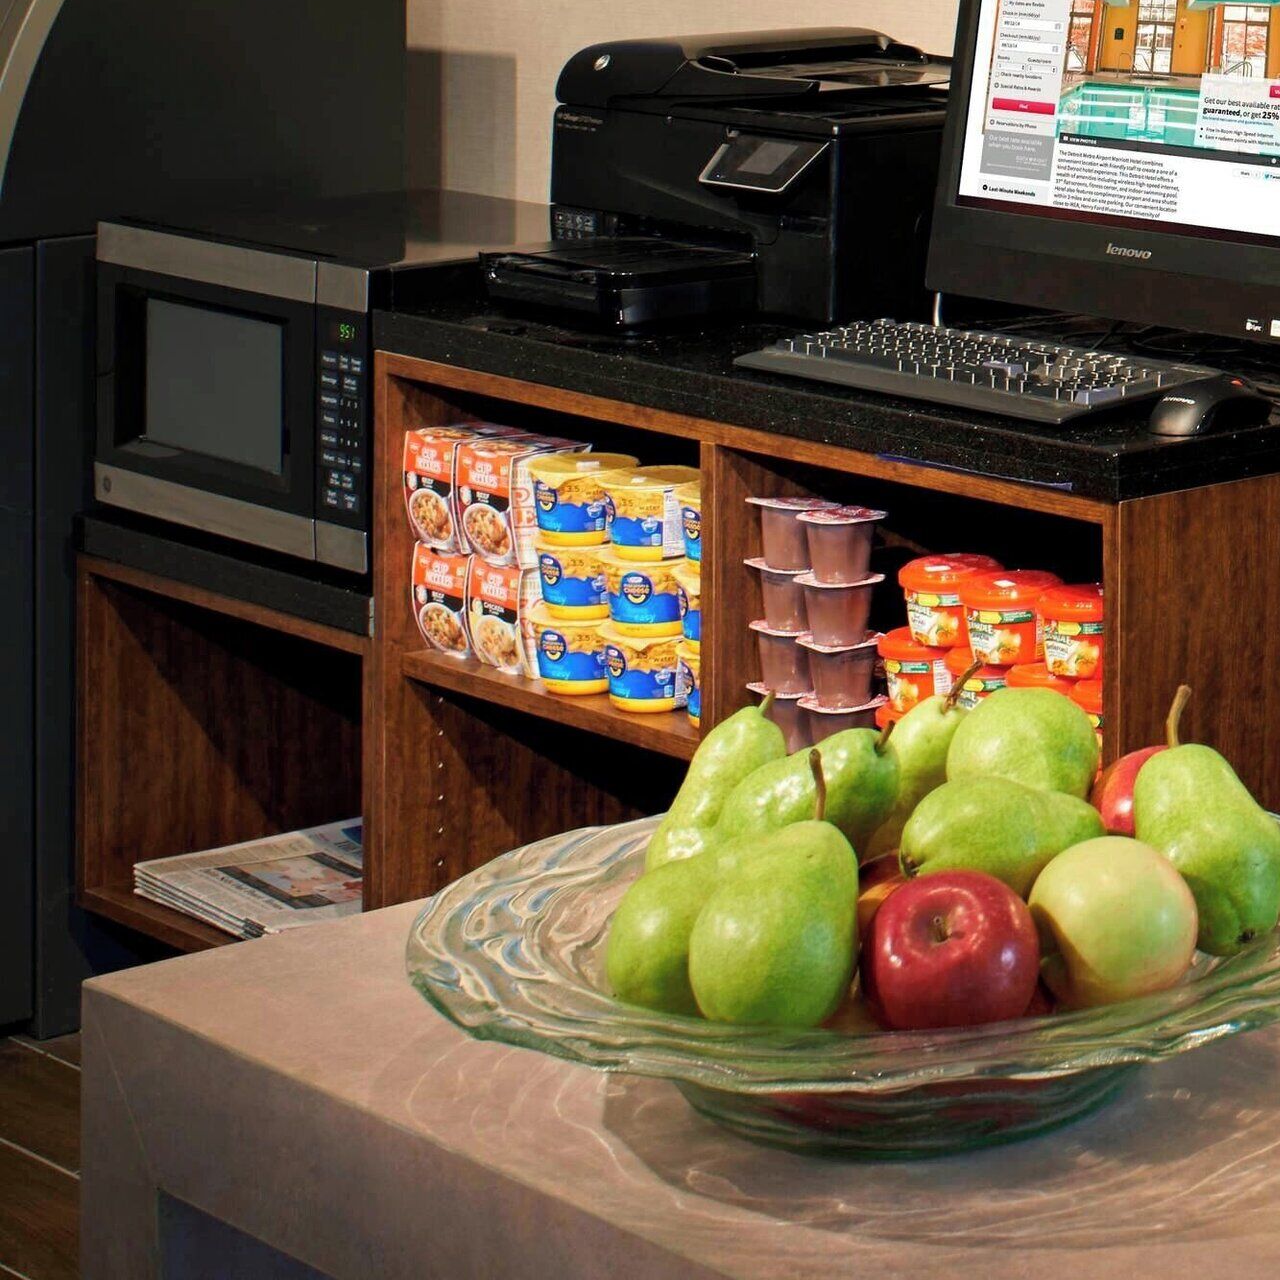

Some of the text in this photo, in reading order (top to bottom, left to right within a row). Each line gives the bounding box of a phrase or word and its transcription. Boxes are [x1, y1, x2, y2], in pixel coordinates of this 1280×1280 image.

[1228, 98, 1241, 106] best
[1242, 100, 1270, 110] available
[1251, 111, 1261, 119] get
[1262, 112, 1280, 120] 25%
[1106, 242, 1152, 260] lenovo
